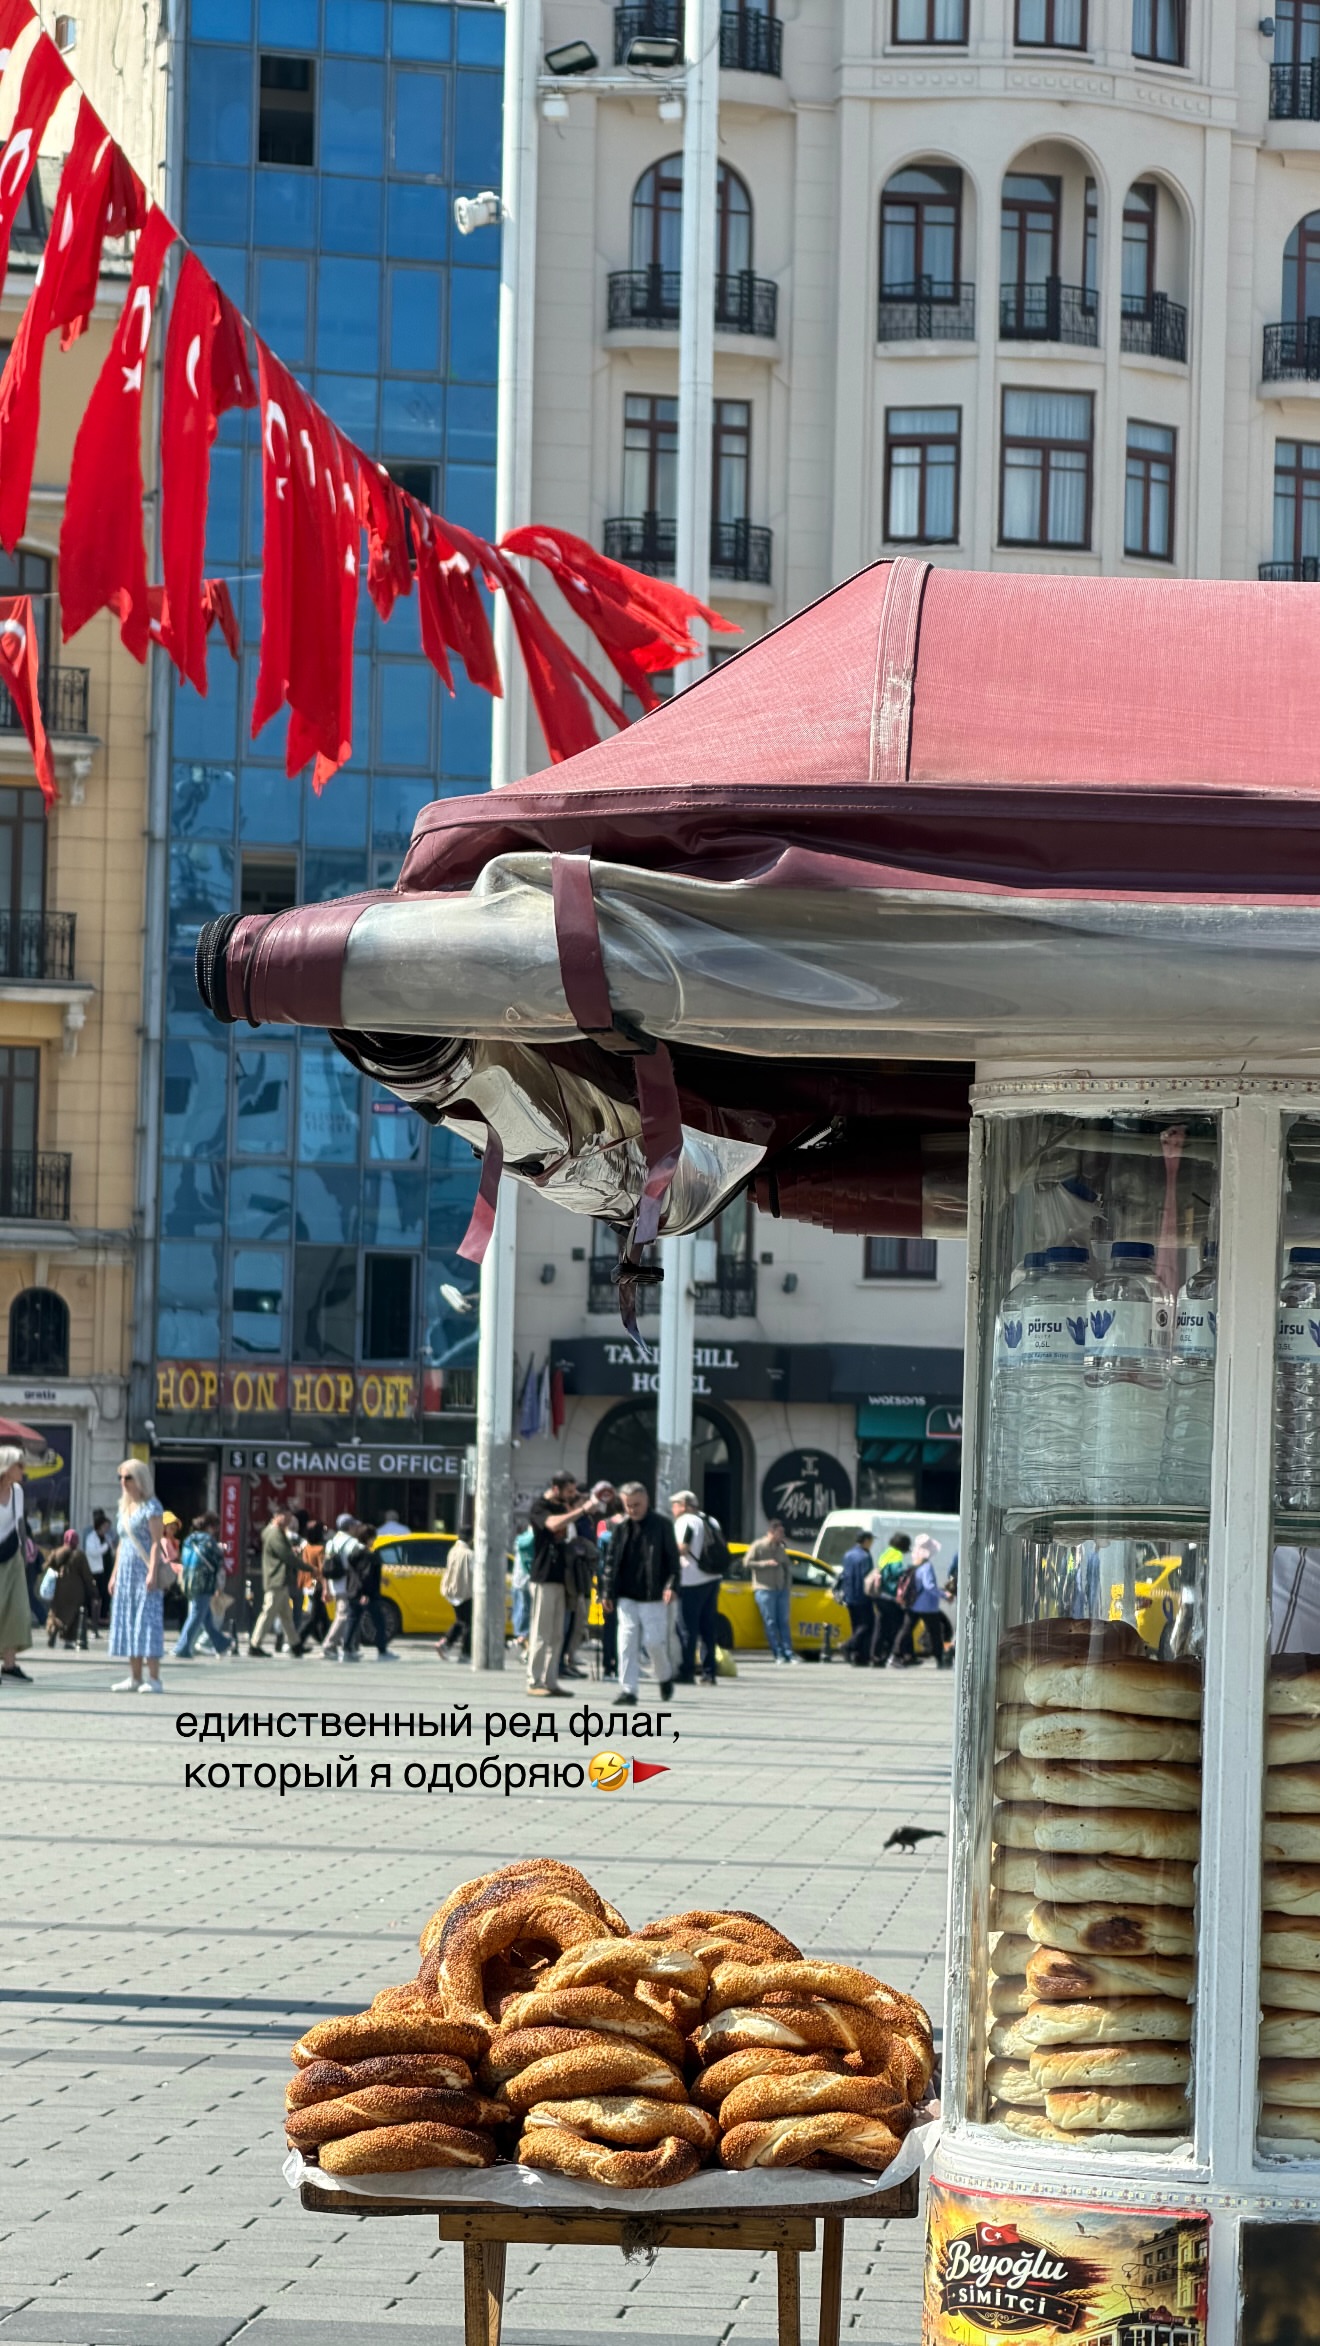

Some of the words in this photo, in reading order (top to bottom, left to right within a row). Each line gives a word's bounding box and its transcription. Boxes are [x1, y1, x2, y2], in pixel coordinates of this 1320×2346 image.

[1028, 1318, 1062, 1336] pürsu
[1279, 1319, 1304, 1335] rsu
[604, 1344, 660, 1365] TAXI
[156, 1367, 218, 1410] HOP
[233, 1371, 279, 1412] ON
[294, 1373, 354, 1413] HOP
[362, 1375, 414, 1418] OFF
[631, 1372, 712, 1395] HOL
[868, 1394, 926, 1406] watsons
[276, 1450, 371, 1471] CHANGE
[379, 1453, 459, 1475] OFFICE
[945, 2241, 1069, 2290] Beyoğlu
[958, 2285, 1047, 2314] SİMİTÇİ
